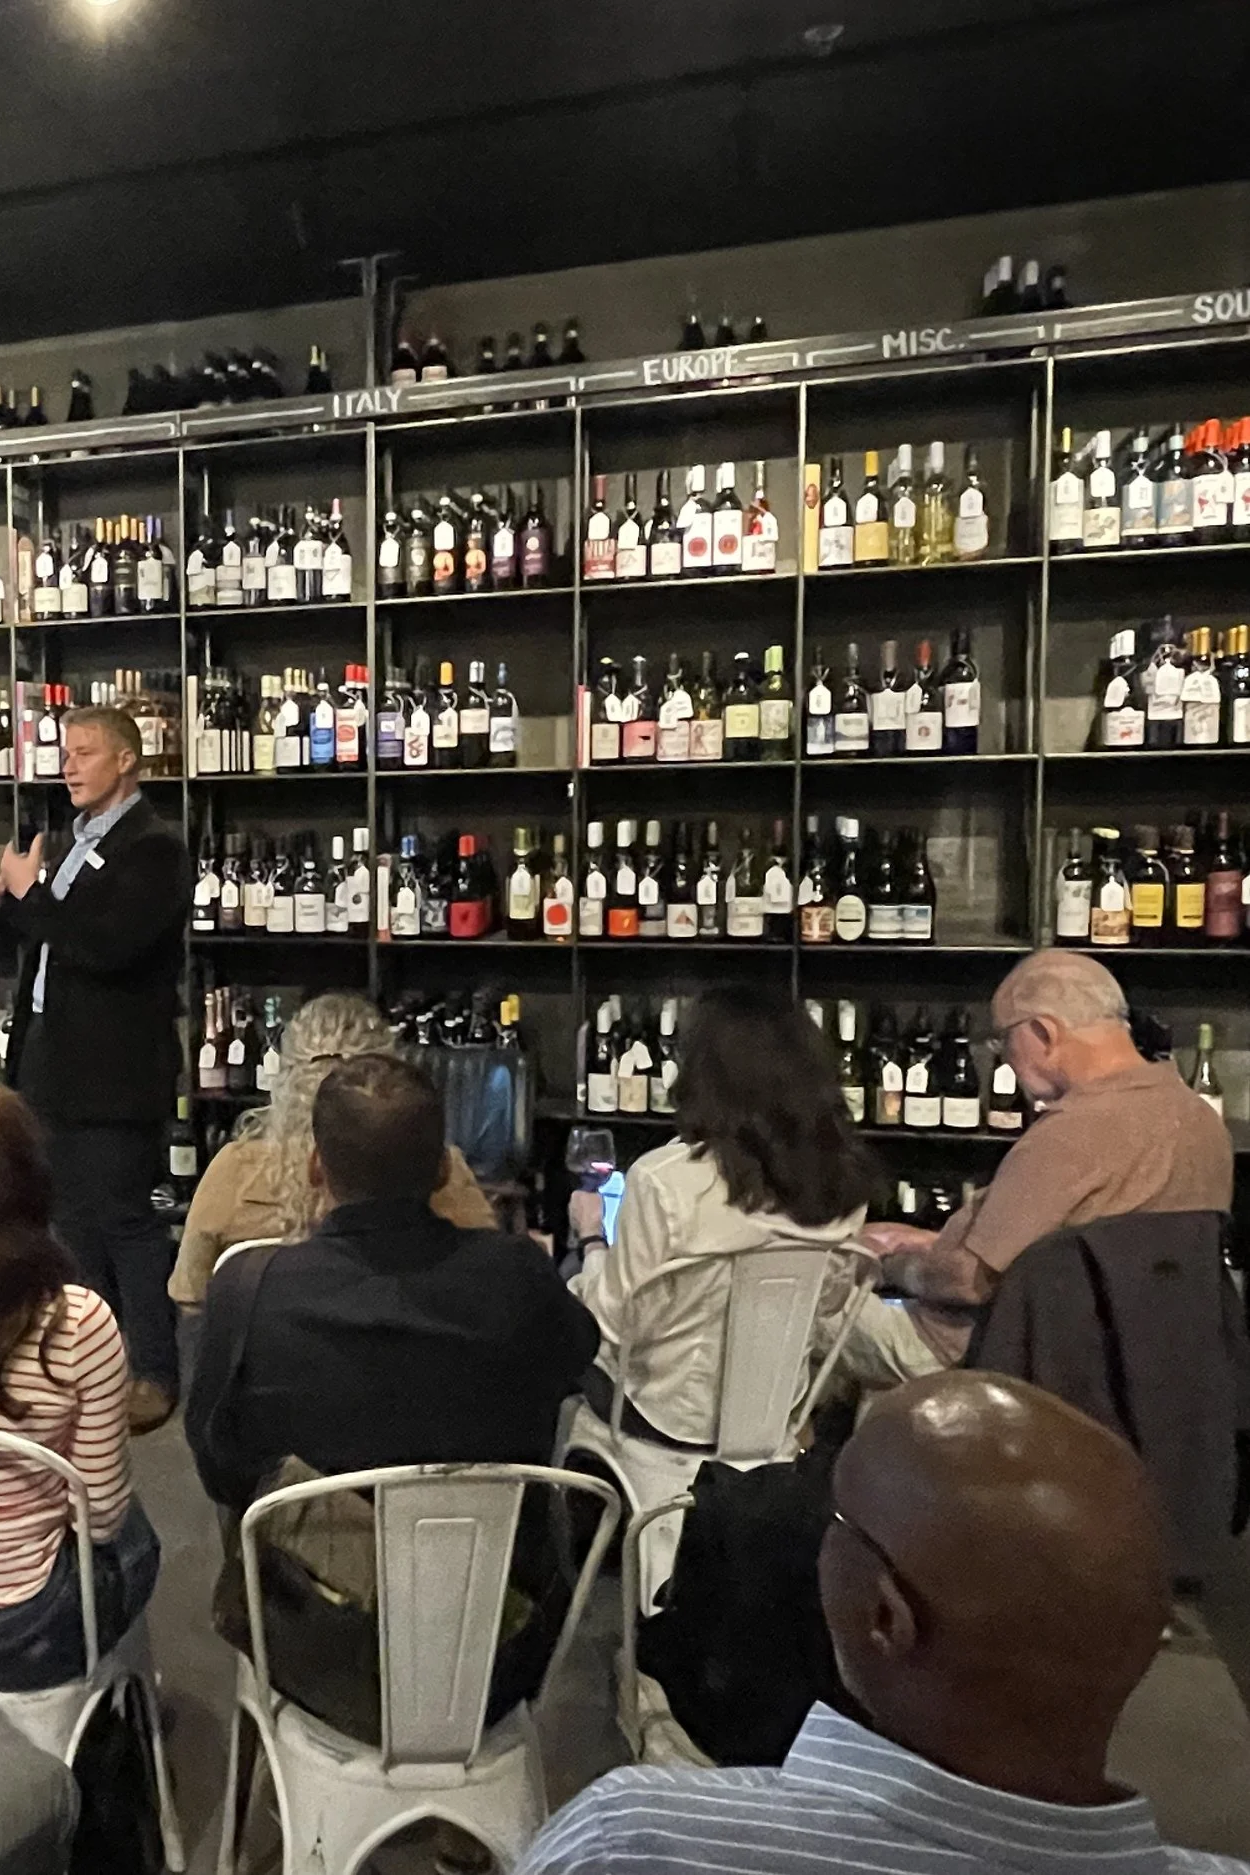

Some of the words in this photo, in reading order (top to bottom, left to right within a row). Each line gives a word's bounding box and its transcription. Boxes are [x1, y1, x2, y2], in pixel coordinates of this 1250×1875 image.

[882, 328, 965, 358] MISC.
[643, 350, 738, 385] EUROPE
[333, 387, 402, 418] ITALY
